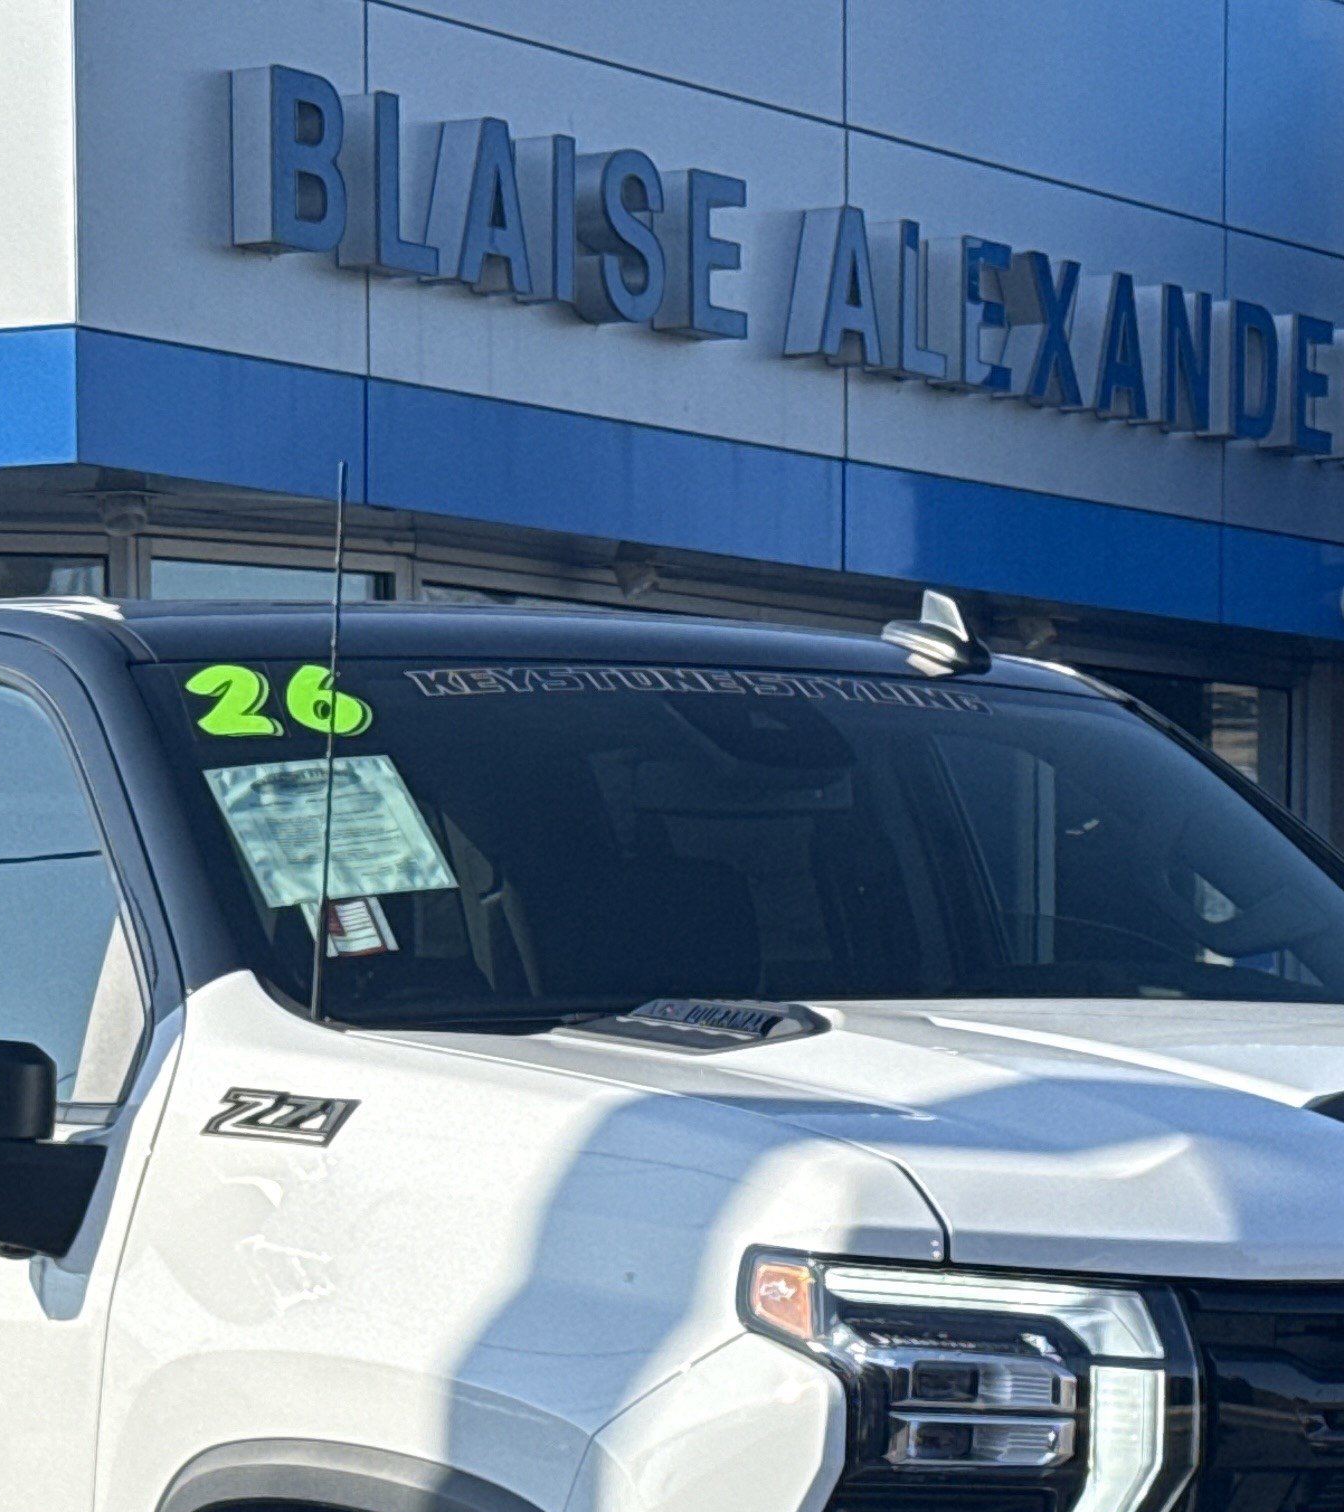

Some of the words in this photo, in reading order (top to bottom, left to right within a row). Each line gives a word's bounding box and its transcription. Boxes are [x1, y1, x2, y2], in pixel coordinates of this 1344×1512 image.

[262, 63, 749, 341] BLAISE
[185, 664, 373, 737] 26
[200, 1086, 362, 1148] Z71
